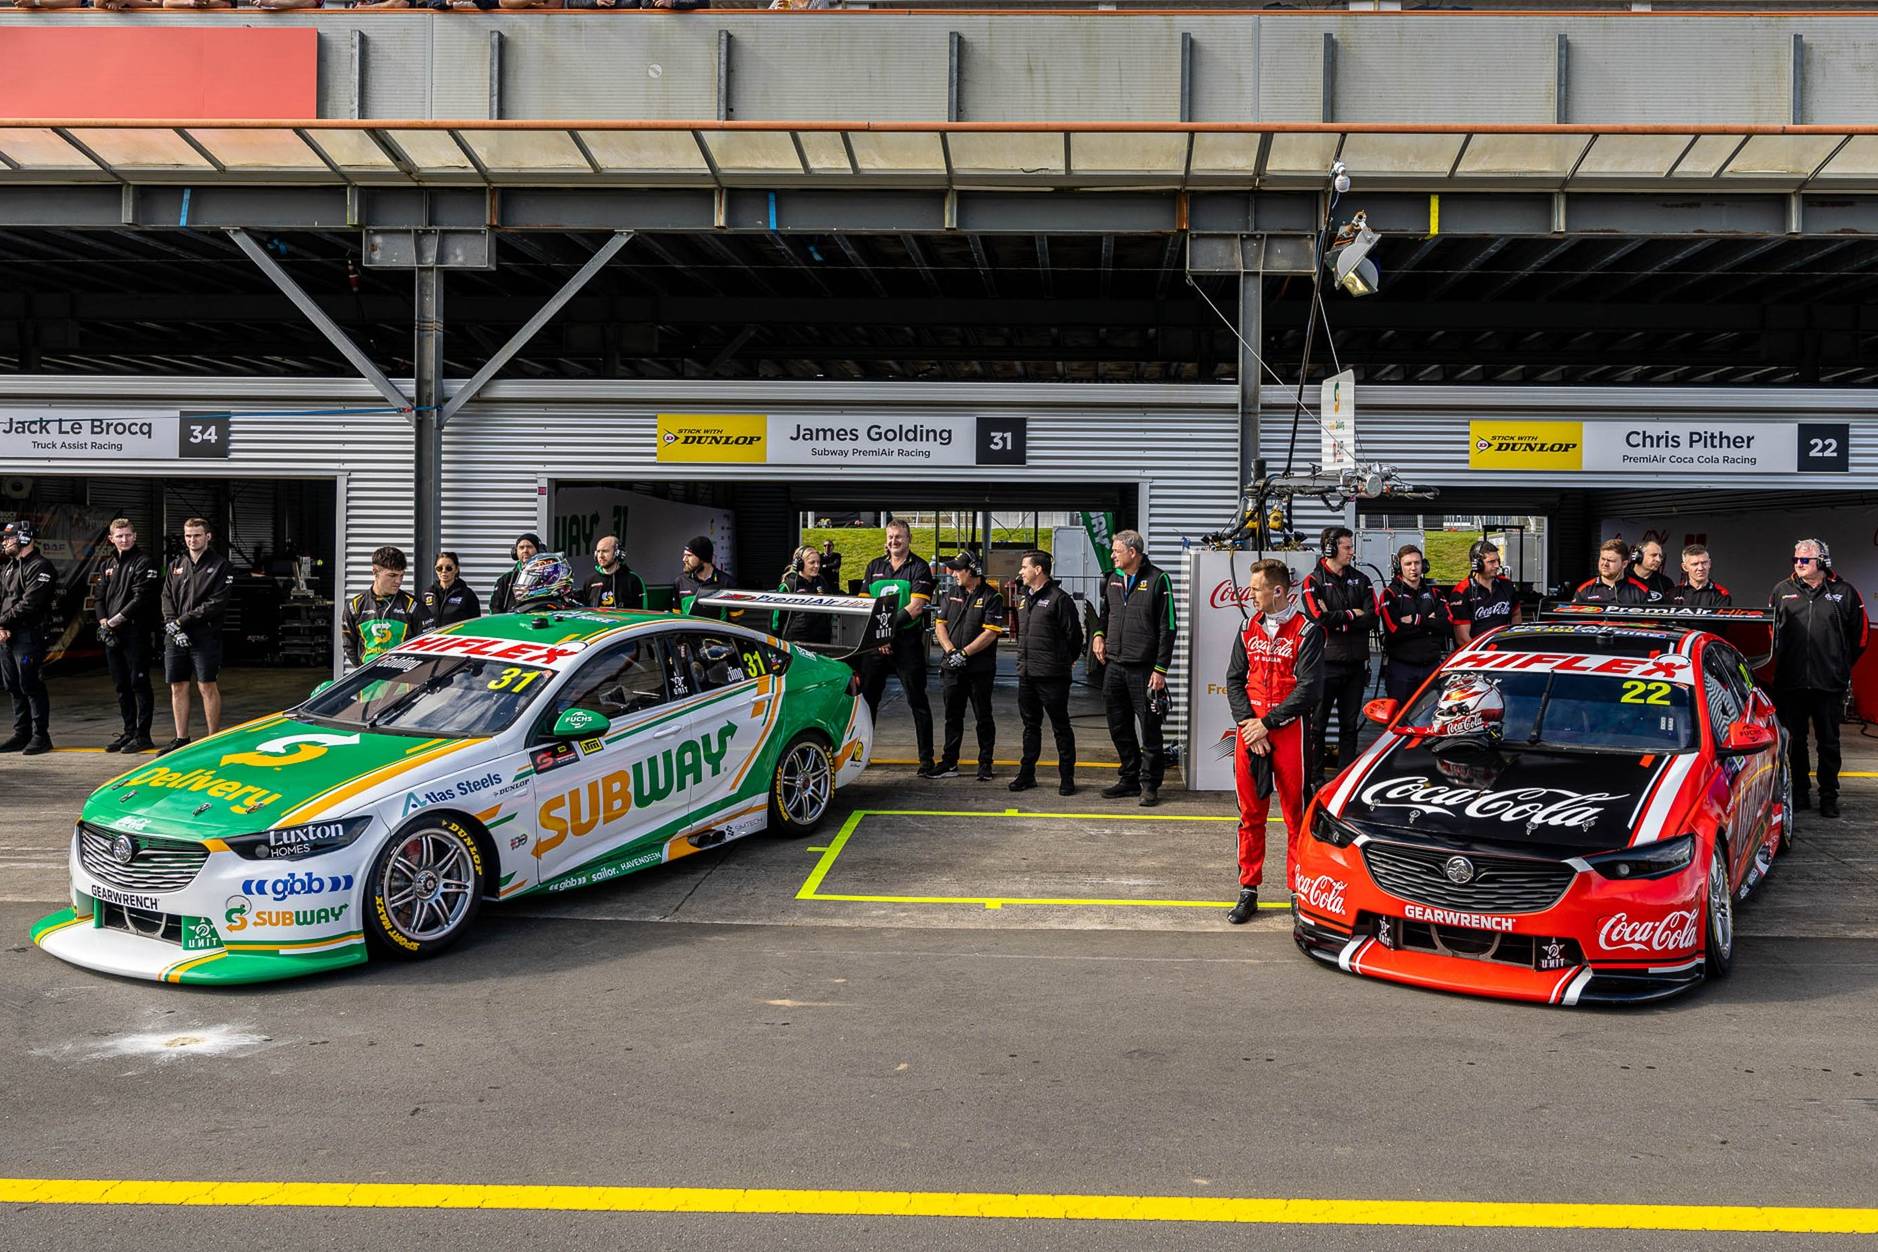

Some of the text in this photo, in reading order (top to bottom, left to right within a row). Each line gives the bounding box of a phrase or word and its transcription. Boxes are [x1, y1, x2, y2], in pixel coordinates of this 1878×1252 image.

[2, 417, 154, 440] Jack Le Brocq
[189, 425, 218, 444] 34
[789, 424, 953, 444] James Golding
[1625, 430, 1755, 449] Chris Pither
[32, 441, 123, 452] Truck Assist Racing
[681, 435, 762, 446] DUNLOP
[989, 431, 1013, 450] 31
[1495, 441, 1578, 453] DUNLOP
[1808, 438, 1839, 457] 22
[811, 447, 931, 459] Subway PremiAir Racing
[1622, 454, 1757, 465] PremiAir Coca Cola Racing
[756, 594, 840, 607] PremiAir
[1603, 604, 1712, 616] PremiAir
[398, 636, 579, 665] HIFLEX
[743, 650, 767, 678] 31
[1444, 650, 1690, 679] HIFLEX
[486, 667, 541, 694] 31
[1619, 680, 1673, 706] 22
[126, 766, 283, 815] Delivery
[401, 772, 503, 819] Atlas Steels
[498, 779, 530, 796] DUNLOP
[530, 720, 739, 861] SUBWAY
[1361, 776, 1631, 827] Coca-Cola
[269, 823, 344, 847] Luxton
[270, 843, 311, 858] HOMES
[448, 822, 484, 876] DUNLOP
[91, 884, 159, 911] GEARWRENCH
[271, 872, 325, 902] gbb
[252, 903, 350, 928] SUBWAY
[1404, 903, 1515, 932] GEARWRENCH
[1598, 908, 1700, 951] Coca-Cola
[188, 937, 218, 949] UNIT
[1541, 958, 1565, 969] UNIT
